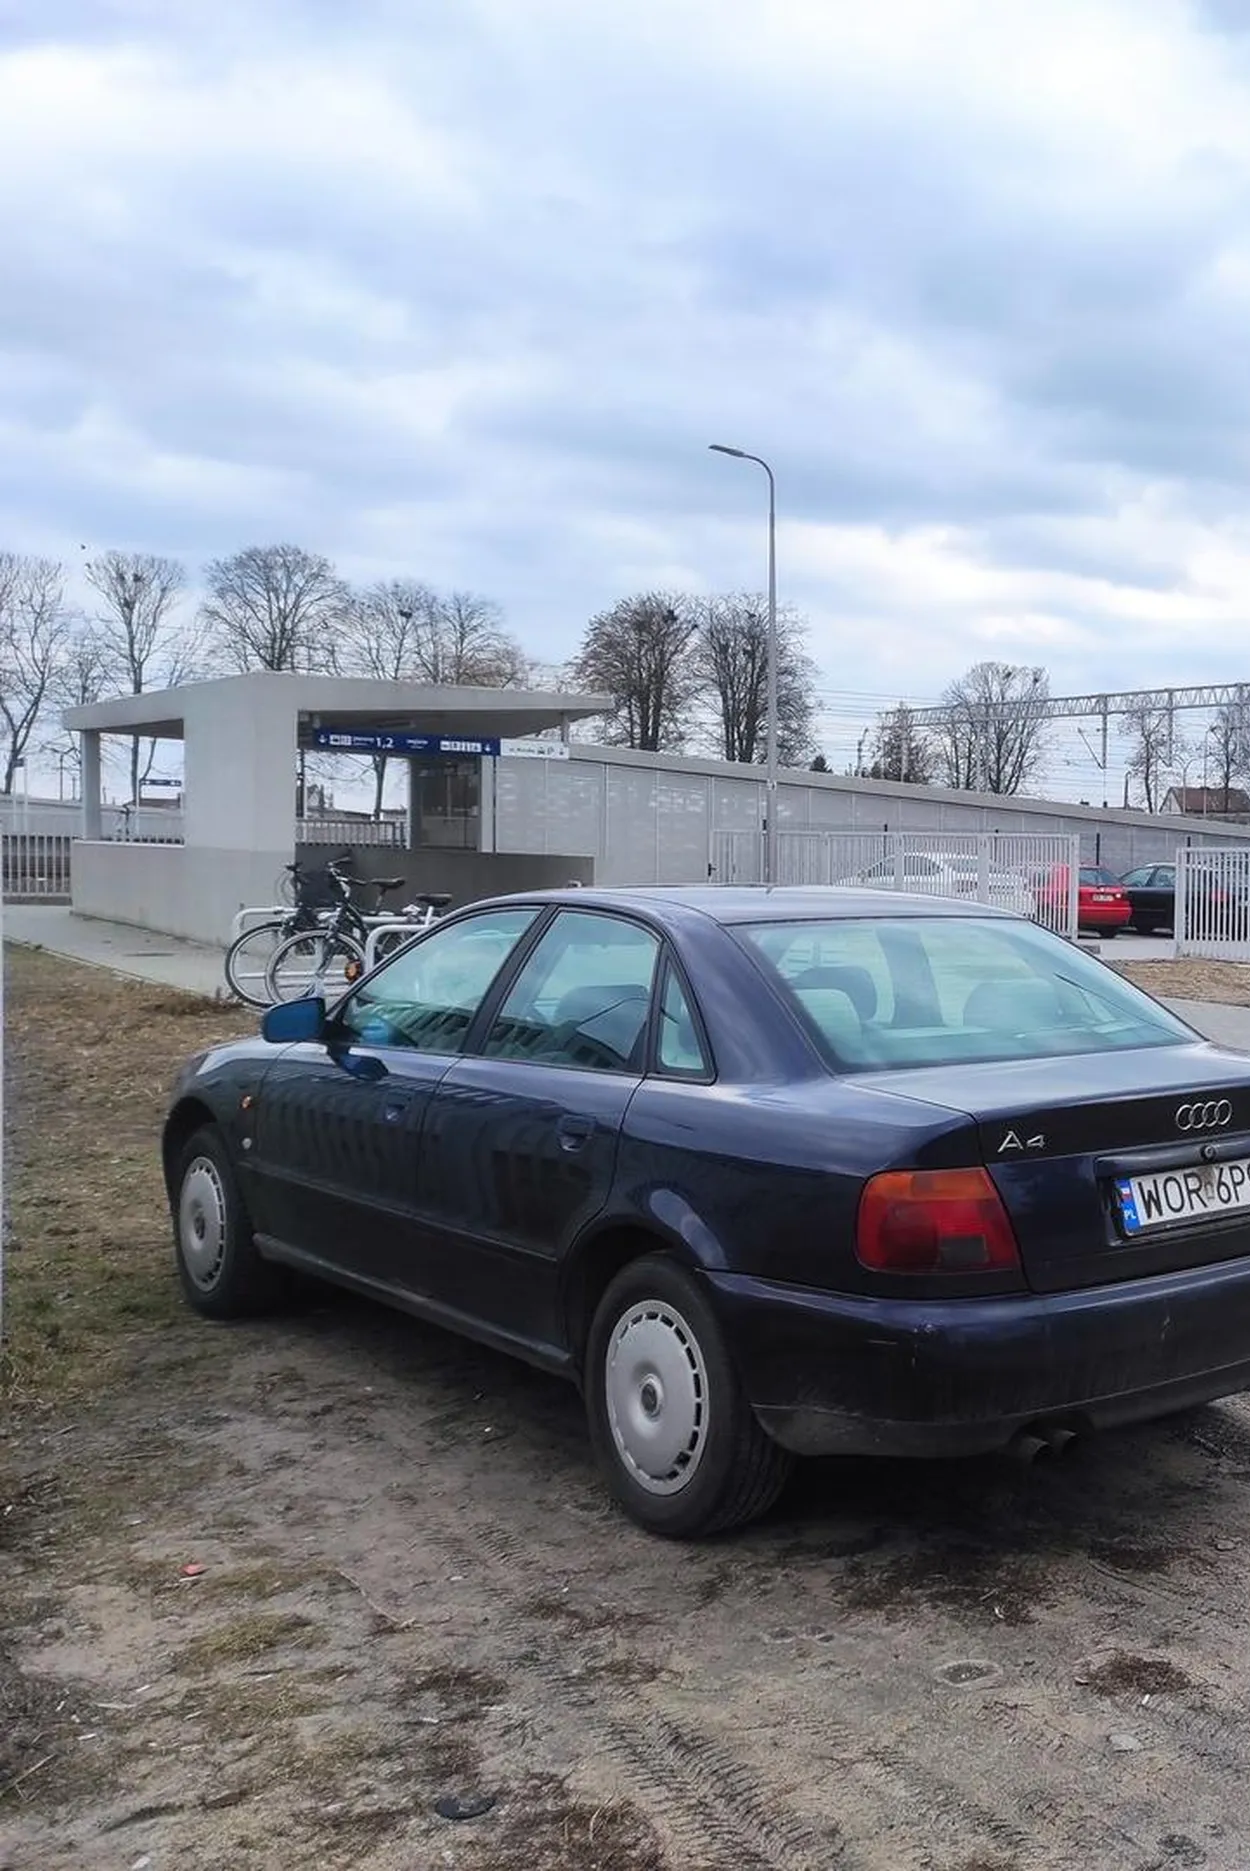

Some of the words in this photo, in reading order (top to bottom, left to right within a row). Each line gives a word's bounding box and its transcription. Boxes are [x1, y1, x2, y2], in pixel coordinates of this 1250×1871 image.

[997, 1130, 1046, 1153] A4
[1138, 1171, 1208, 1218] WOR
[1124, 1209, 1137, 1221] PL
